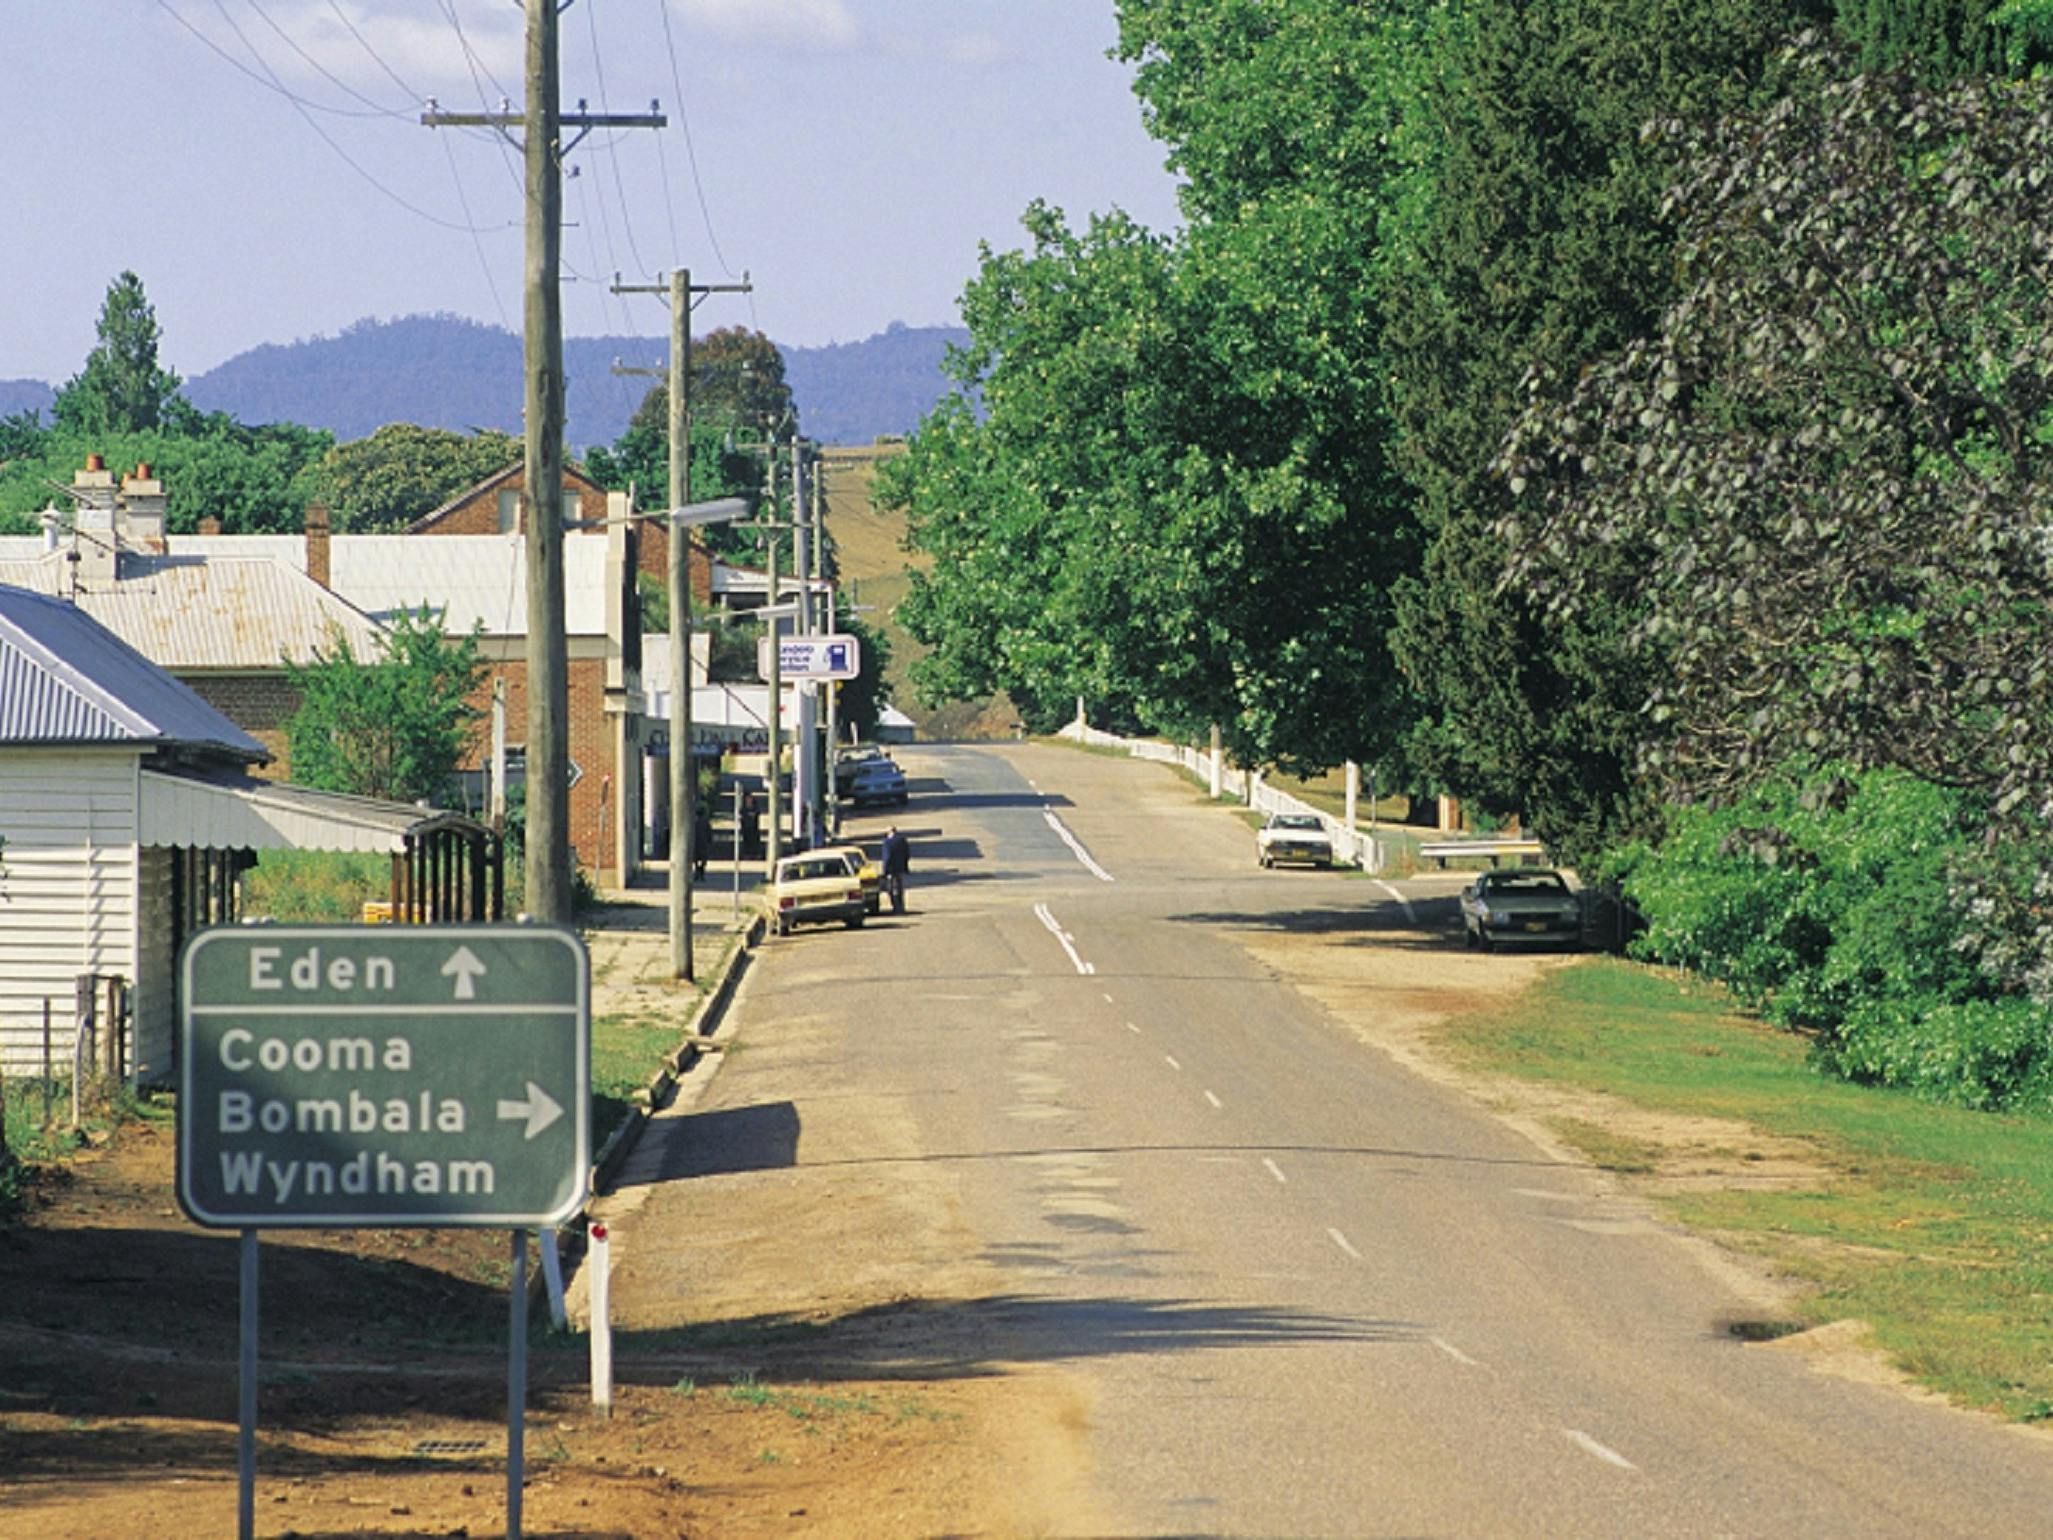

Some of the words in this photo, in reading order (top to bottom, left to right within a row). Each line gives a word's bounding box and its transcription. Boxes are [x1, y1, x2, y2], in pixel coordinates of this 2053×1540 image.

[249, 945, 396, 991] Eden
[218, 1028, 412, 1072] Cooma
[218, 1089, 466, 1133] Bombala
[219, 1151, 495, 1204] Wyndham
